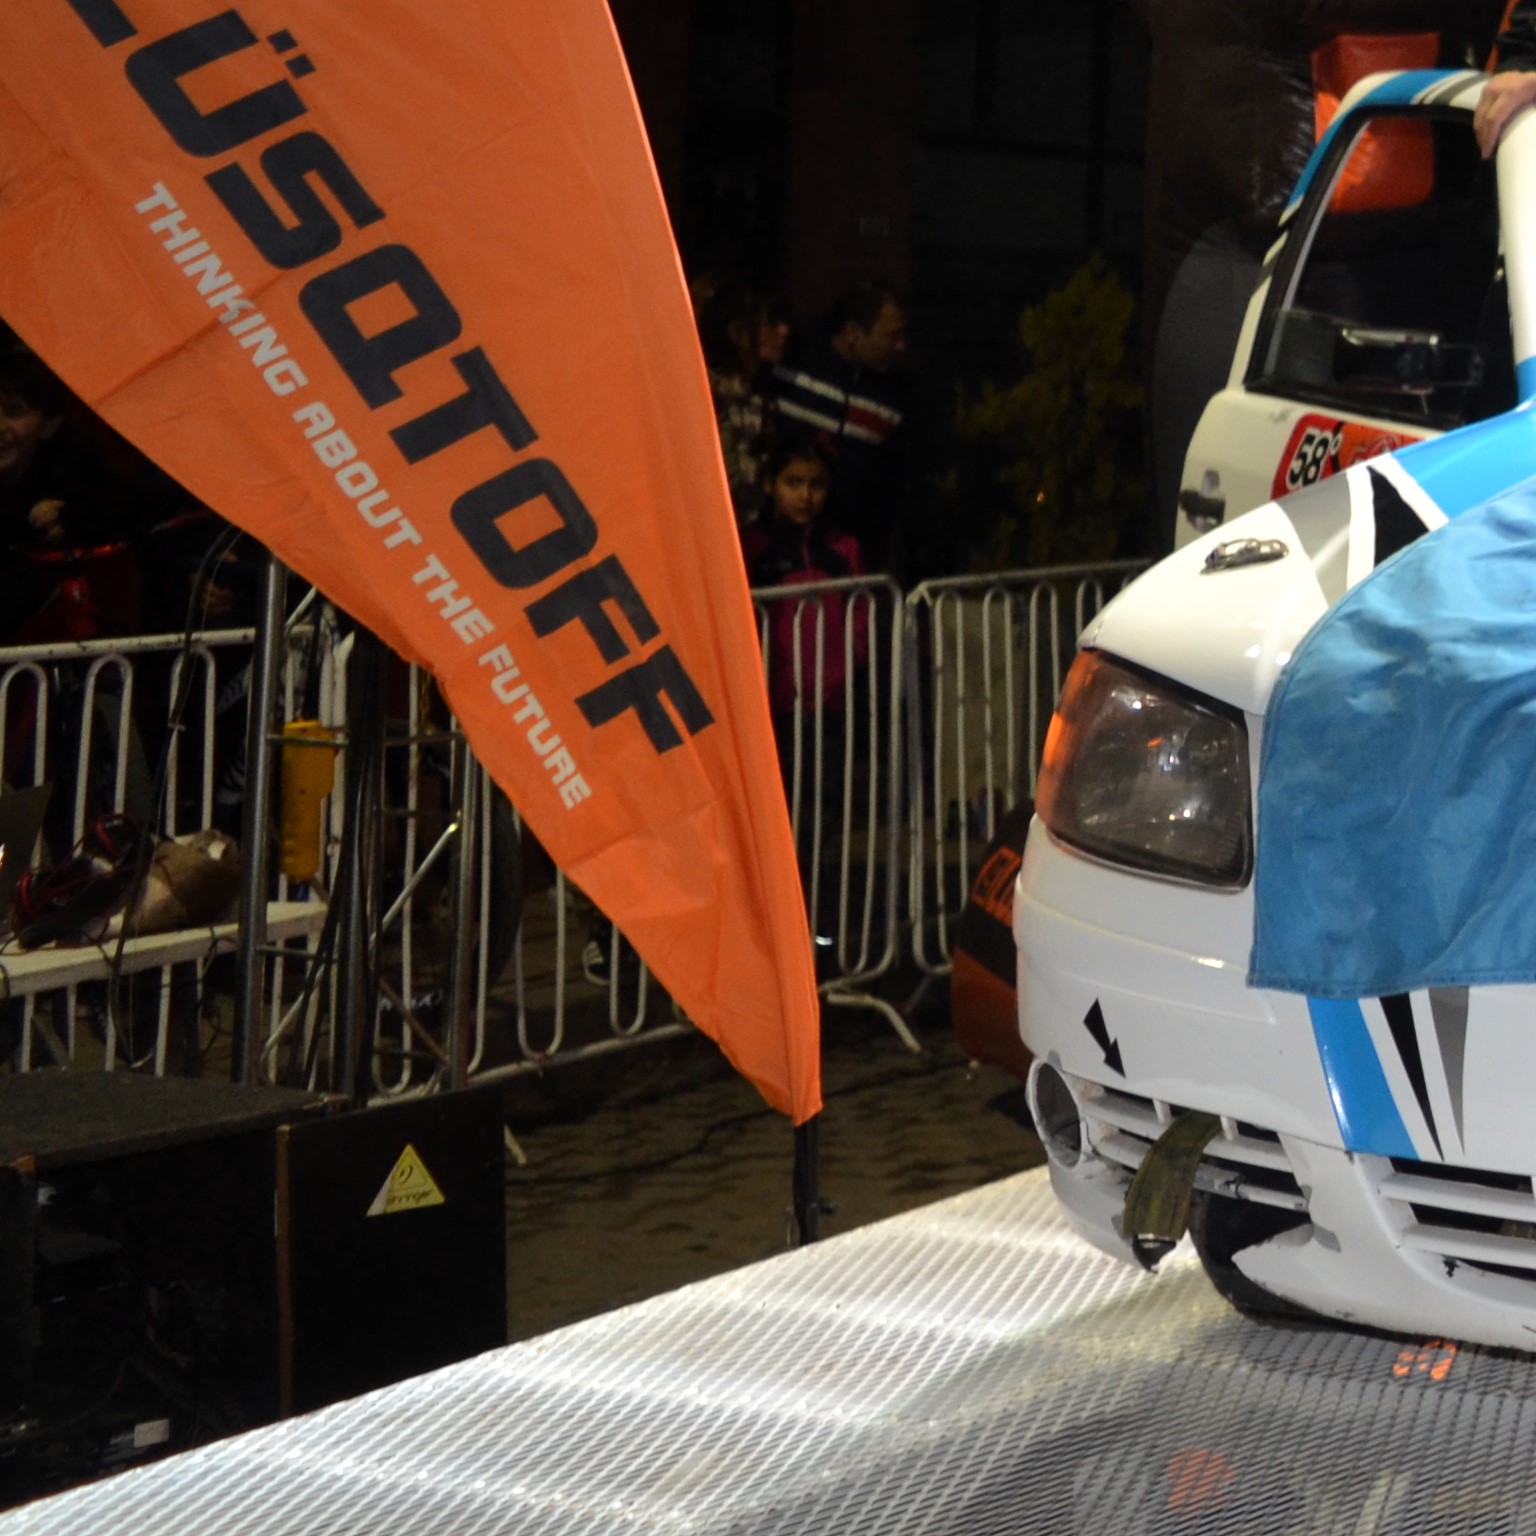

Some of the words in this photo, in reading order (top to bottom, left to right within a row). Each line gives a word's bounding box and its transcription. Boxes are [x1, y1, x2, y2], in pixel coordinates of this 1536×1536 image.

[133, 183, 309, 398] THINKING
[291, 399, 423, 553] ABOUT
[410, 553, 496, 647] THE
[477, 643, 594, 811] FUTURE
